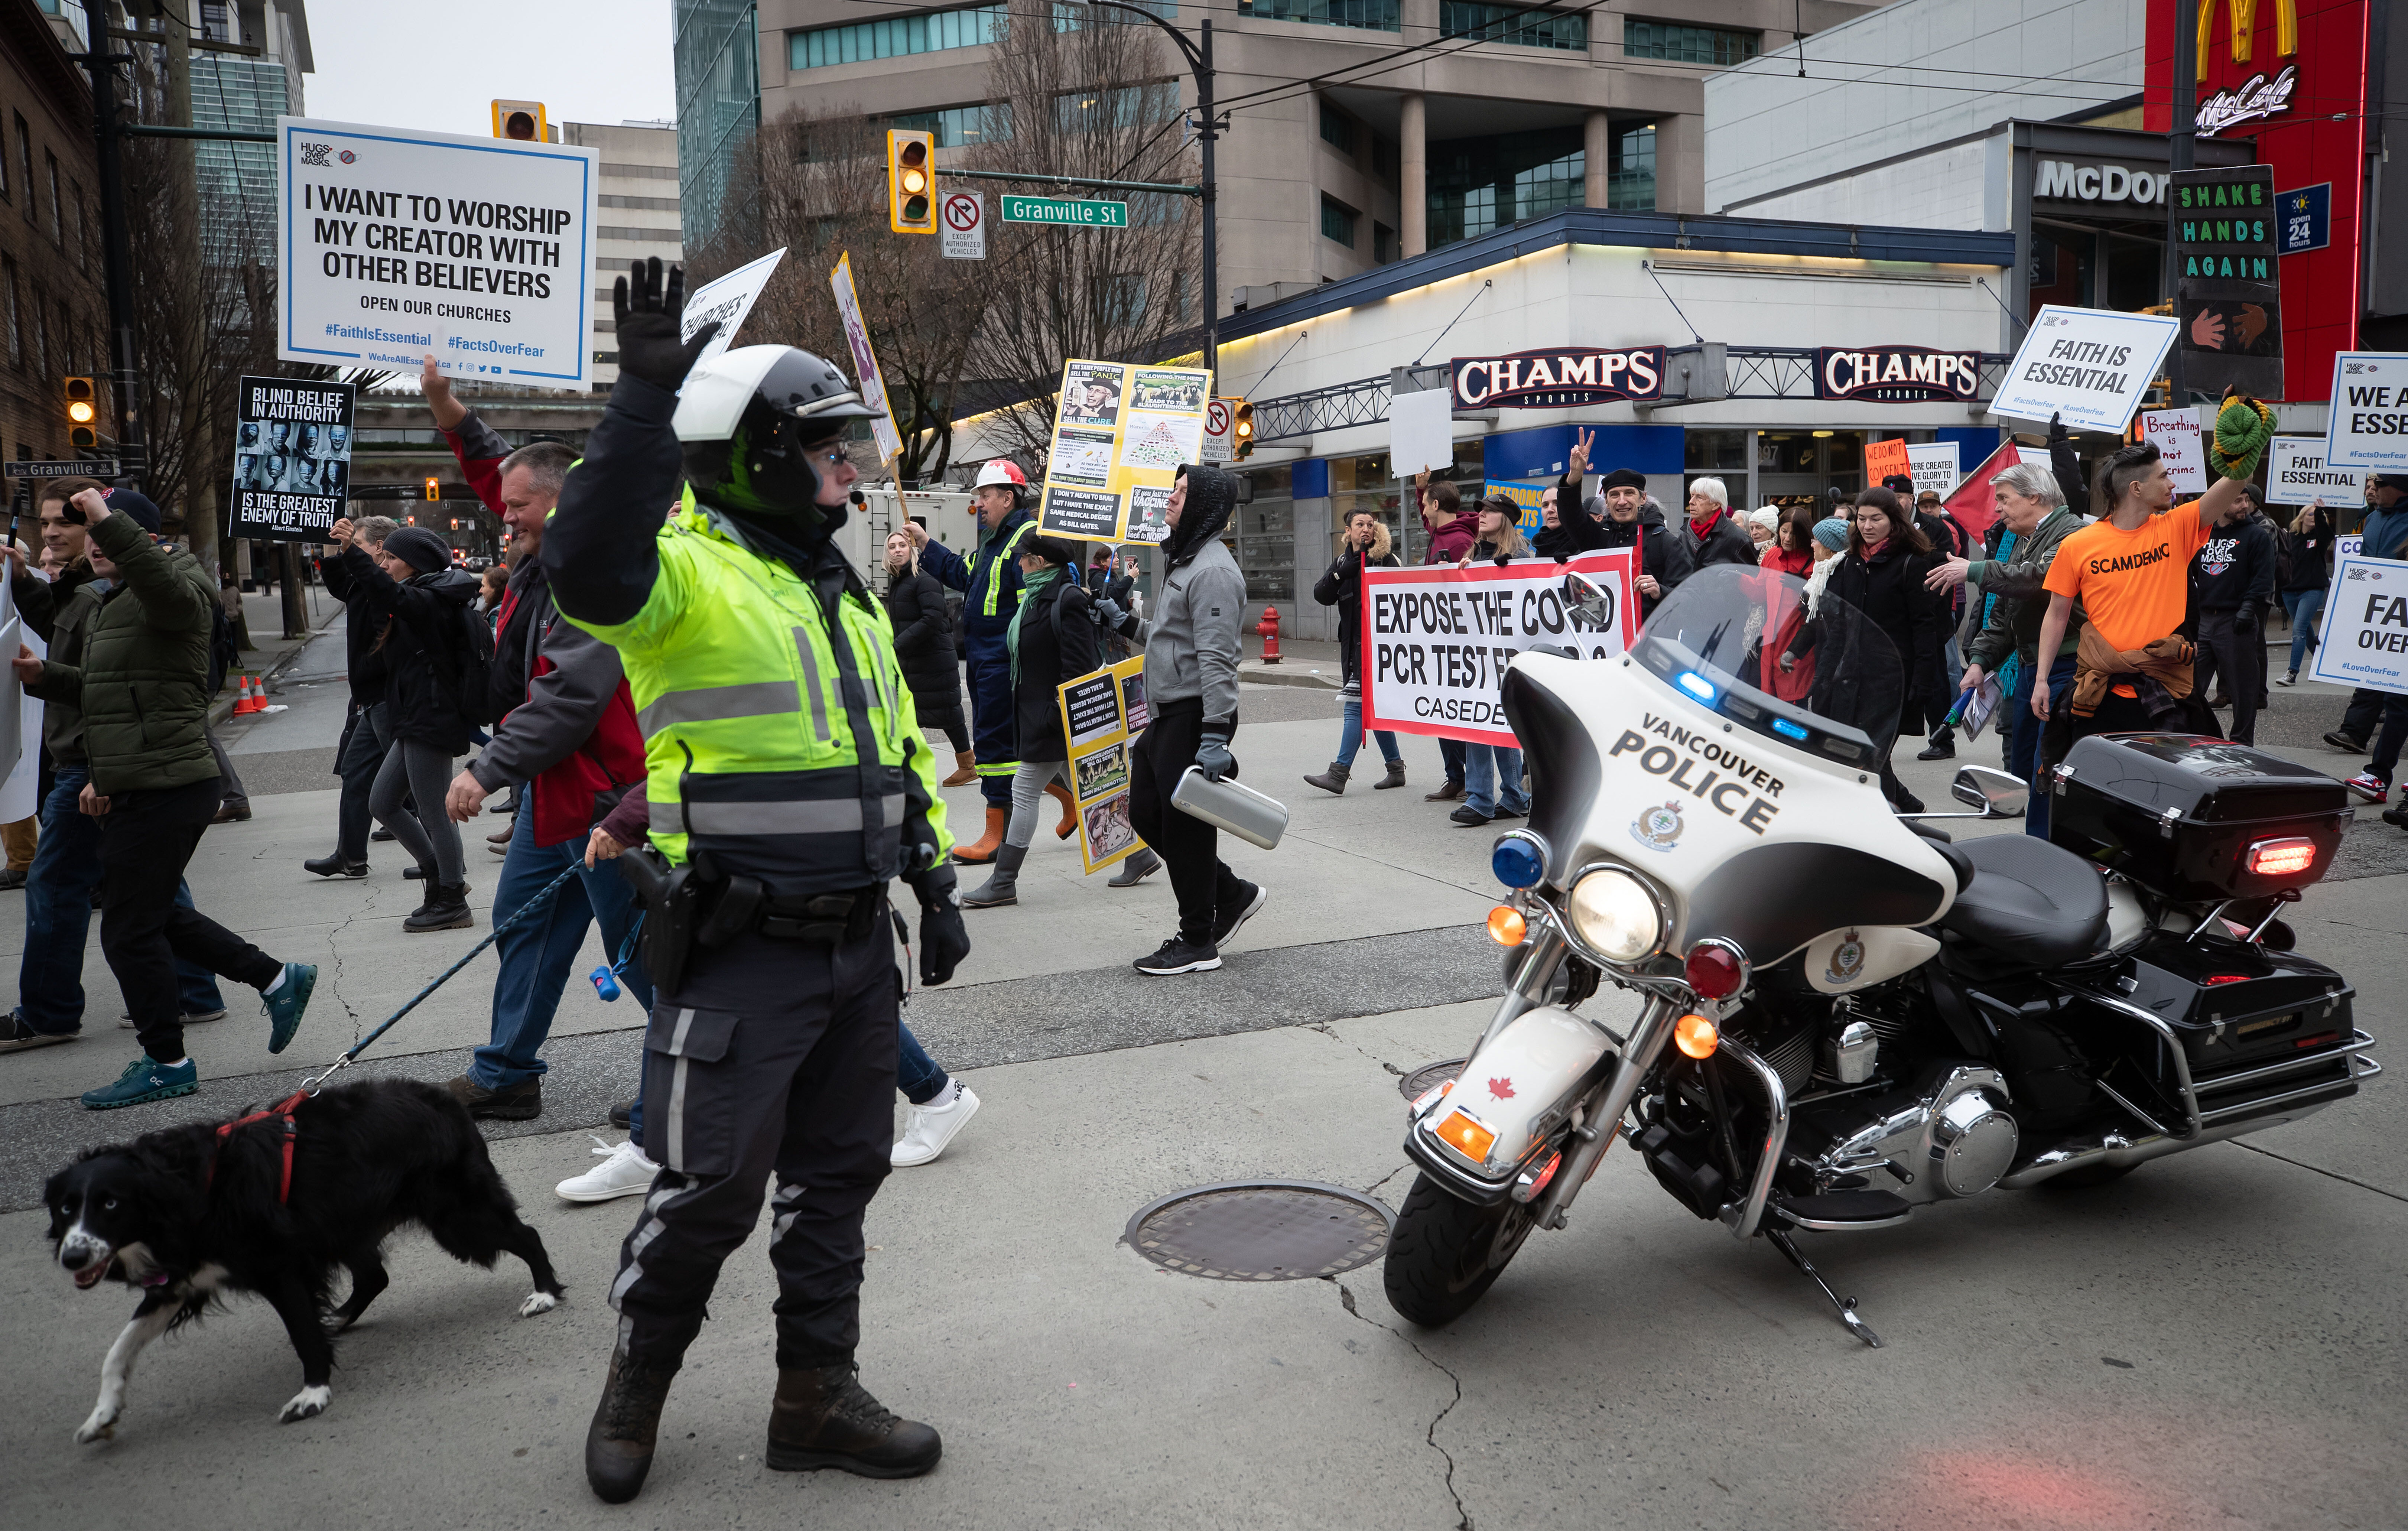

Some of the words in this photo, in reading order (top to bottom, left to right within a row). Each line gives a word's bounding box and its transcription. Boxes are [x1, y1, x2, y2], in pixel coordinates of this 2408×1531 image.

[301, 142, 329, 153] HUGS
[2033, 160, 2170, 204] McDon
[2181, 184, 2262, 207] SHAKE
[305, 184, 311, 209] I
[318, 185, 402, 218] WANT
[407, 194, 441, 223] TO
[448, 199, 571, 235] WORSHIP
[1014, 201, 1093, 222] Granville
[1101, 206, 1117, 223] St
[2290, 214, 2310, 225] open
[2183, 220, 2264, 241] HANDS
[2289, 222, 2310, 241] 24
[315, 218, 358, 247] MY
[365, 223, 482, 260] CREATOR
[489, 236, 559, 268] WITH
[2290, 238, 2310, 248] hours
[323, 251, 407, 285] OTHER
[415, 261, 550, 299] BELIEVERS
[2187, 257, 2266, 279] AGAIN
[360, 295, 398, 312] OPEN
[404, 300, 432, 315] OUR
[437, 303, 511, 323] CHURCHES
[325, 324, 431, 346] #FaithIsEssential
[448, 336, 545, 357] #FactsOverFear
[2048, 339, 2109, 364] FAITH
[2106, 346, 2132, 366] IS
[1091, 371, 1121, 380] PANIC
[1457, 351, 1658, 404] CHAMPS
[1826, 351, 1977, 396] CHAMPS
[2023, 361, 2128, 394] ESSENTIAL
[253, 387, 293, 404] BLIND
[297, 390, 344, 407] BELIEF
[1524, 391, 1589, 405] SPORTS
[1878, 389, 1927, 399] SPORTS
[2348, 386, 2391, 407] WE
[252, 402, 266, 417] IN
[268, 403, 342, 423] AUTHORITY
[1137, 402, 1195, 410] SLAUGHTERHOUSE
[2013, 397, 2056, 409] #FactsOverFear
[2063, 404, 2106, 416] #LoveOverFear
[2147, 415, 2200, 436] Breathing
[2168, 436, 2176, 445] is
[1867, 446, 1878, 460] WE
[1879, 446, 1887, 458] DO
[1888, 442, 1901, 457] NOT
[2162, 450, 2181, 459] not
[2350, 451, 2407, 459] #FactsOverFear
[30, 463, 93, 475] Granville
[1869, 462, 1905, 481] CONSENT
[1926, 461, 1953, 470] CREATED
[2167, 466, 2197, 475] crime.
[1912, 472, 1921, 480] IVE
[1923, 471, 1941, 480] GLORY
[1942, 471, 1951, 479] TO
[2281, 471, 2356, 486] ESSENTIAL
[1151, 490, 1162, 498] just
[1916, 481, 1948, 490] TOGETHER
[242, 492, 254, 507] IS
[256, 493, 277, 509] THE
[279, 495, 337, 514] GREATEST
[241, 507, 279, 524] ENEMY
[281, 510, 296, 525] OF
[298, 511, 334, 528] TRUTH
[1066, 510, 1090, 519] MEDICAL
[1127, 530, 1140, 539] back
[2203, 539, 2236, 549] HUGS
[2090, 543, 2170, 575] SCAMDEMIC
[1375, 592, 1468, 635] EXPOSE
[1465, 591, 1513, 636] THE
[2363, 594, 2408, 628] FA
[1378, 643, 1427, 685] PCR
[1431, 645, 1488, 689] TEST
[2342, 662, 2400, 677] #LoveOverFear
[1087, 693, 1103, 705] MEDICAL
[1103, 690, 1114, 699] SAME
[1070, 701, 1086, 711] DEGREE
[1095, 703, 1105, 713] HAVE
[1415, 696, 1510, 726] CASEDE
[1073, 710, 1086, 721] EXACT
[1092, 715, 1102, 725] MEAN
[1075, 722, 1086, 731] BRAG
[1081, 745, 1119, 764] SLAUGHTERHOUSE
[1102, 753, 1115, 761] LEADS
[1642, 712, 1784, 799] VANCOUVER
[1102, 775, 1127, 789] FOLLOWING
[1609, 729, 1780, 836] POLICE
[1081, 790, 1093, 798] HERD
